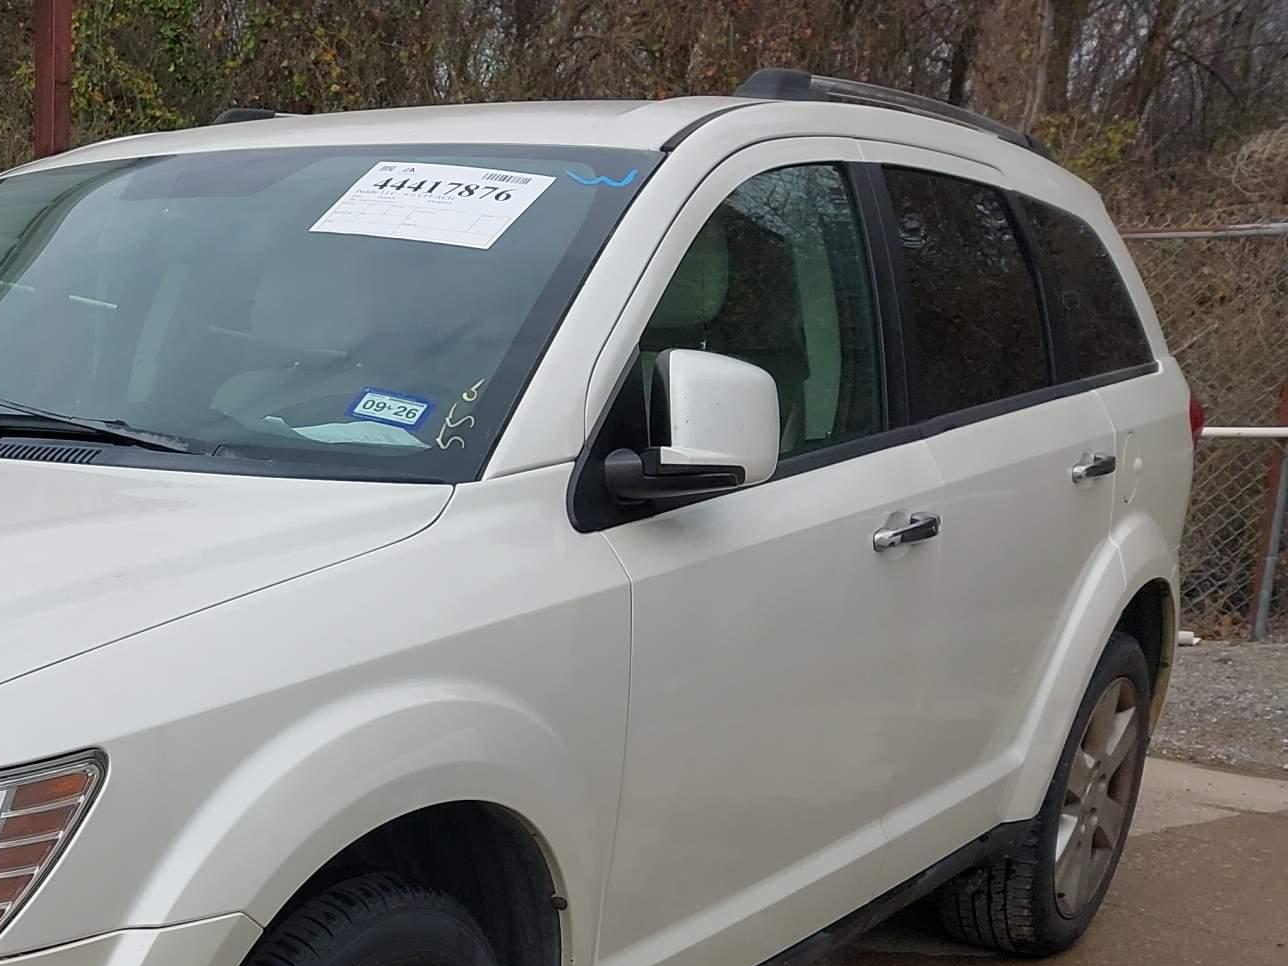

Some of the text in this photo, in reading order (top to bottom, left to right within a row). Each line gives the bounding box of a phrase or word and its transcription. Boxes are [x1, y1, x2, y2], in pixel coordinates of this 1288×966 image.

[372, 177, 519, 202] 44417876
[362, 399, 419, 419] 09 26
